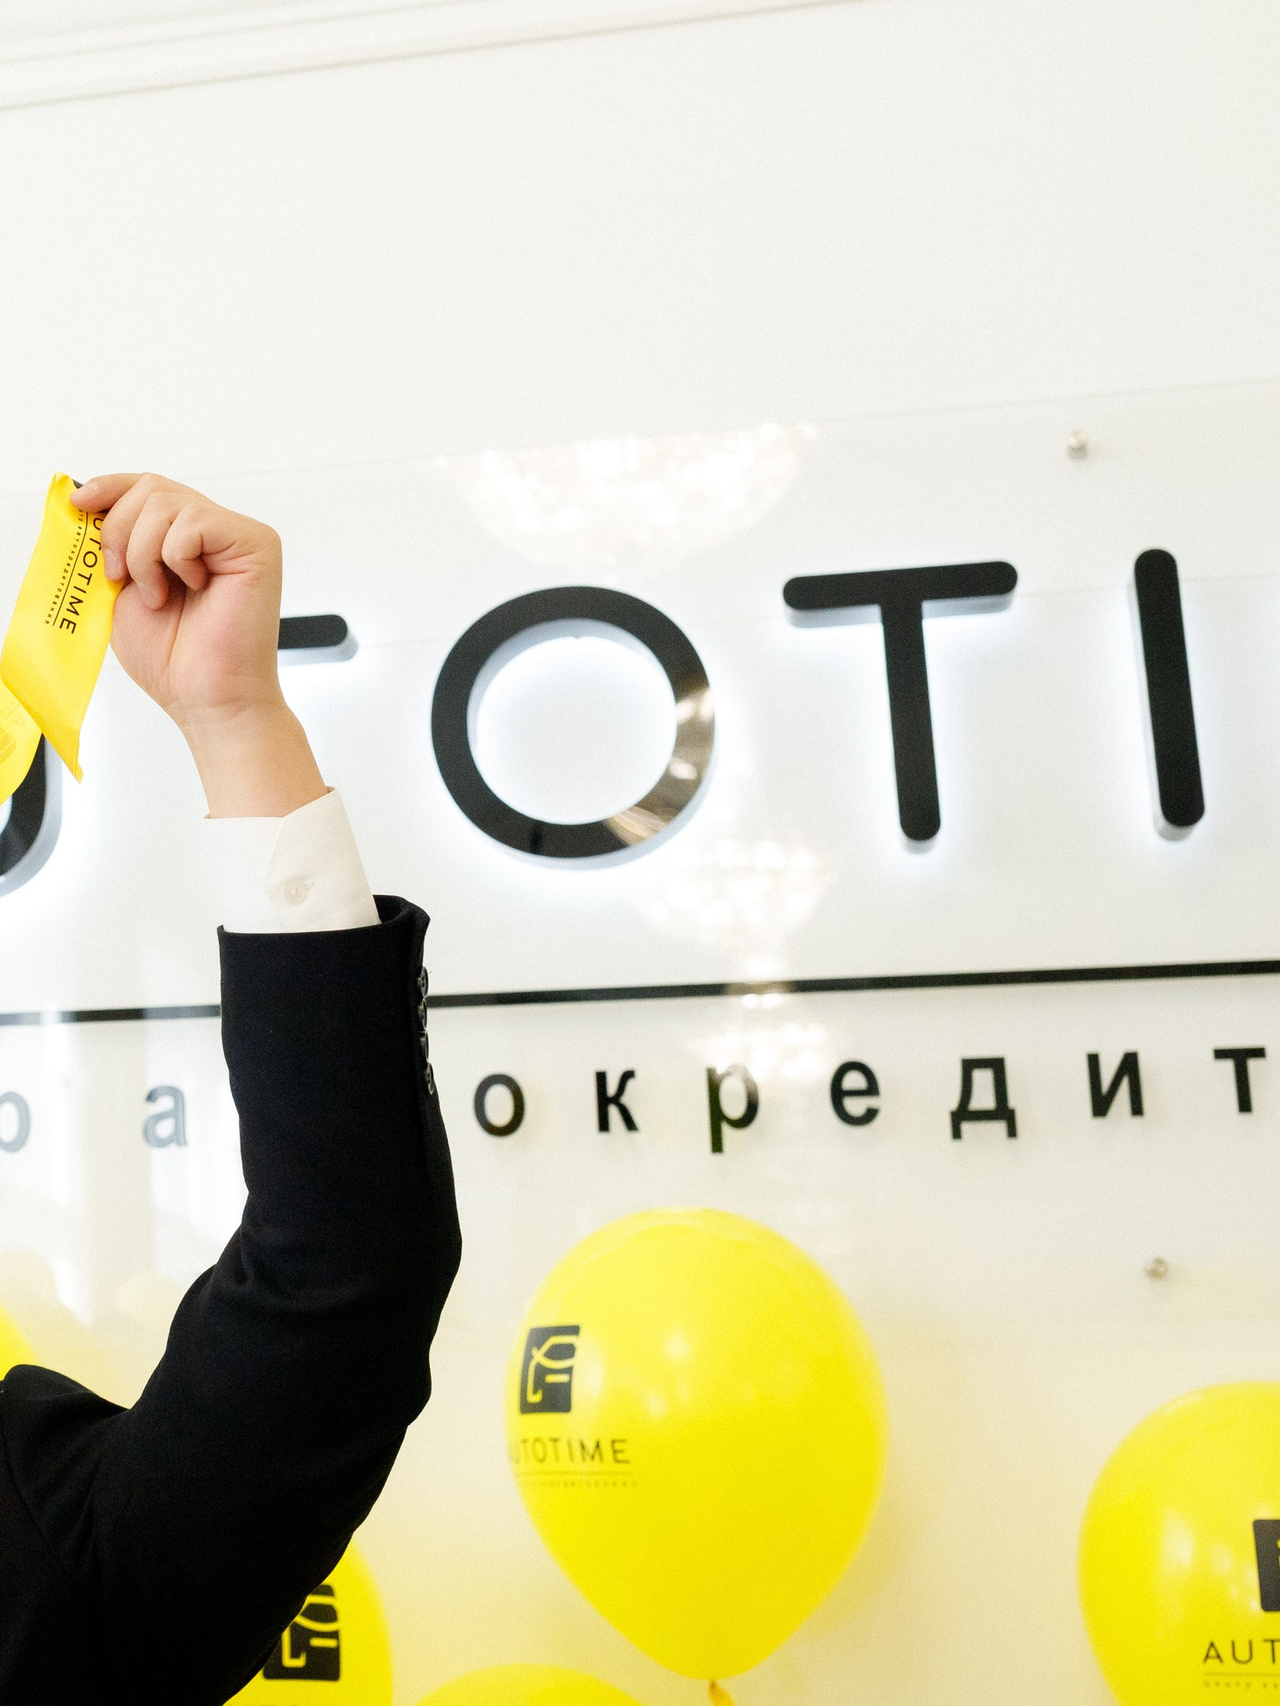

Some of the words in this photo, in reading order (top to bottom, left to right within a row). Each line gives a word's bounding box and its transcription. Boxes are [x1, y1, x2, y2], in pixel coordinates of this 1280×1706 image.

[59, 517, 103, 634] UTOTIME
[142, 1047, 1267, 1153] аокредит
[1202, 1638, 1280, 1665] AUT
